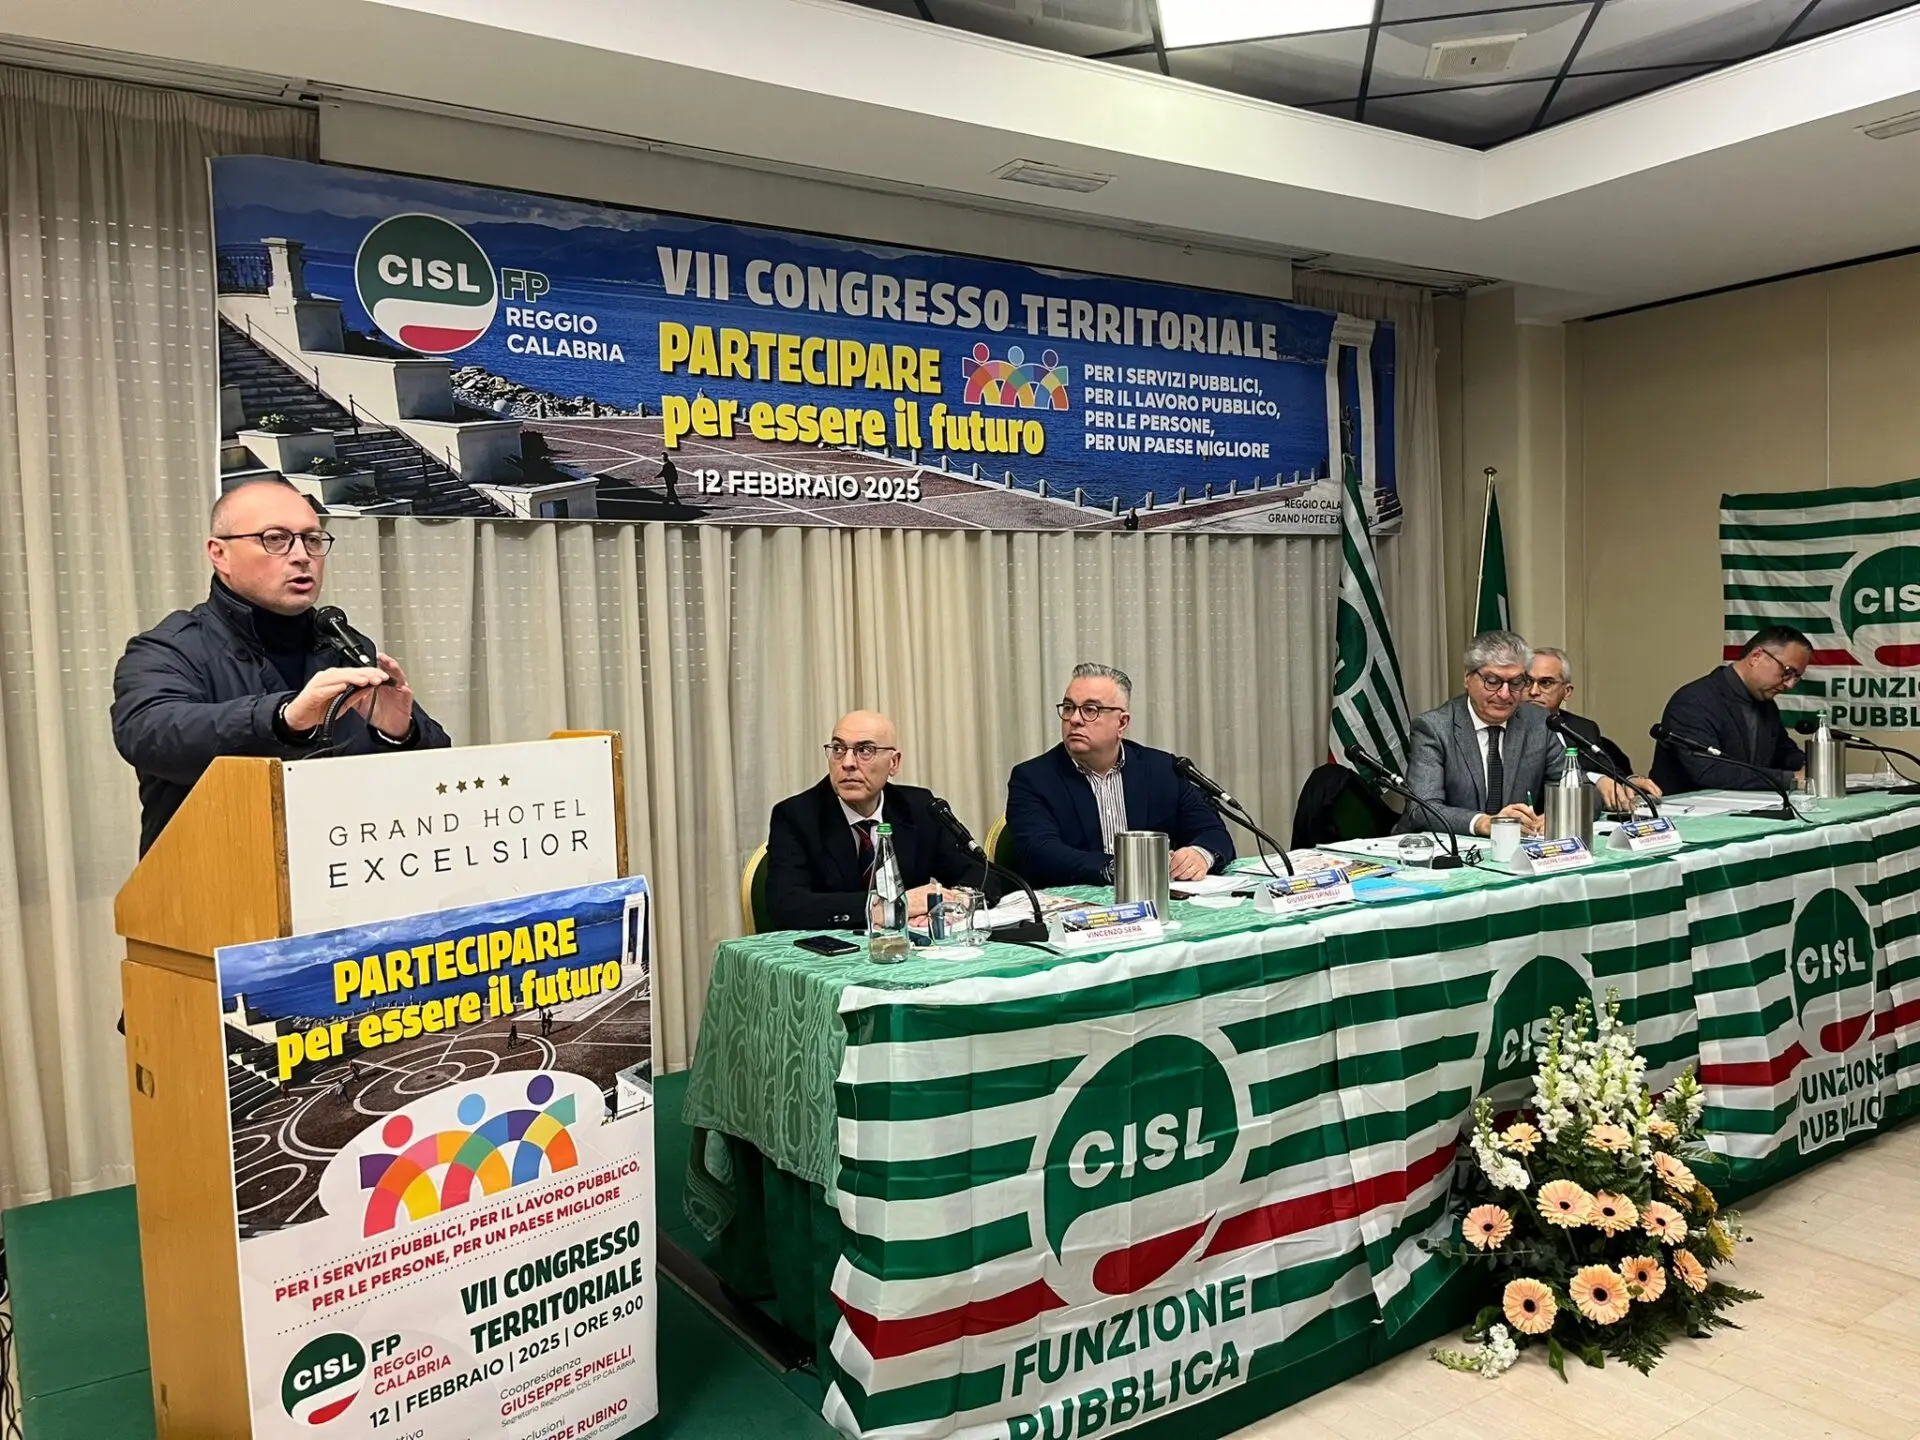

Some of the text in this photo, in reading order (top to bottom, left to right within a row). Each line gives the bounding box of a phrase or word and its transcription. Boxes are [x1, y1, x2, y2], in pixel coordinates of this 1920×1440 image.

[377, 254, 481, 294] CISL
[501, 268, 551, 303] FP
[506, 306, 598, 335] REGGIO
[656, 246, 1278, 360] VII CONGRESSO TERRITORIALE
[507, 334, 625, 363] CALABRIA
[658, 321, 942, 395] PARTECIPARE
[1084, 364, 1263, 397] PER I SERVIZI PUBBLICI,
[1085, 387, 1281, 419] PER IL LAVORO PUBBLICO,
[1085, 410, 1215, 437] PER LE PERSONE,
[662, 394, 1045, 455] per essere il futuro
[1085, 434, 1270, 458] PER UN PAESE MIGLIORE
[694, 469, 921, 502] 12 FEBBRAIO 2025
[1284, 499, 1342, 510] REGGIO CALA
[1268, 514, 1300, 523] GRAND
[1301, 514, 1329, 524] HOTEL
[1854, 584, 1920, 614] CIS
[1832, 677, 1920, 698] FUNZI
[1832, 706, 1920, 727] PUBBL
[329, 798, 588, 847] GRAND HOTEL
[329, 830, 590, 889] EXCELSIOR
[1286, 893, 1315, 904] GIUSEPPE
[1316, 889, 1341, 898] SPINELLI
[1086, 927, 1123, 939] VINCENZO
[1124, 925, 1143, 934] SERA
[333, 917, 578, 1004] PARTECIPARE
[1799, 936, 1866, 984] CISL
[277, 959, 622, 1081] per essere il futuro
[1497, 1016, 1573, 1071] CIS
[1798, 1053, 1884, 1104] UNZIONE
[1068, 1107, 1215, 1189] CISL
[275, 1161, 641, 1302] PER I SERVIZI PUBBLICI, PER IL LAVORO PUBBLICO,
[312, 1187, 621, 1311] PER LE PERSONE, PER UN PAESE MIGLIORE
[460, 1220, 640, 1315] VII CONGRESSO
[470, 1256, 643, 1355] TERRITORIALE
[371, 1333, 402, 1363] FP
[1011, 1275, 1246, 1397] FUNZIONE
[293, 1352, 358, 1393] CISL
[369, 1295, 644, 1429] 12 FEBBRAIO 2025 ORE 9.00
[373, 1344, 434, 1380] REGGIO
[374, 1353, 452, 1397] CALABRIA
[500, 1356, 582, 1400] Coopresidenza
[501, 1345, 632, 1416] GIUSEPPE SPINELLI
[501, 1357, 637, 1428] Segretario Regionale CISL FP CALABRIA
[1007, 1340, 1241, 1440] PUBBLICA
[521, 1415, 566, 1440] clusioni
[577, 1398, 628, 1434] RUBINO
[600, 1413, 628, 1433] Calabria
